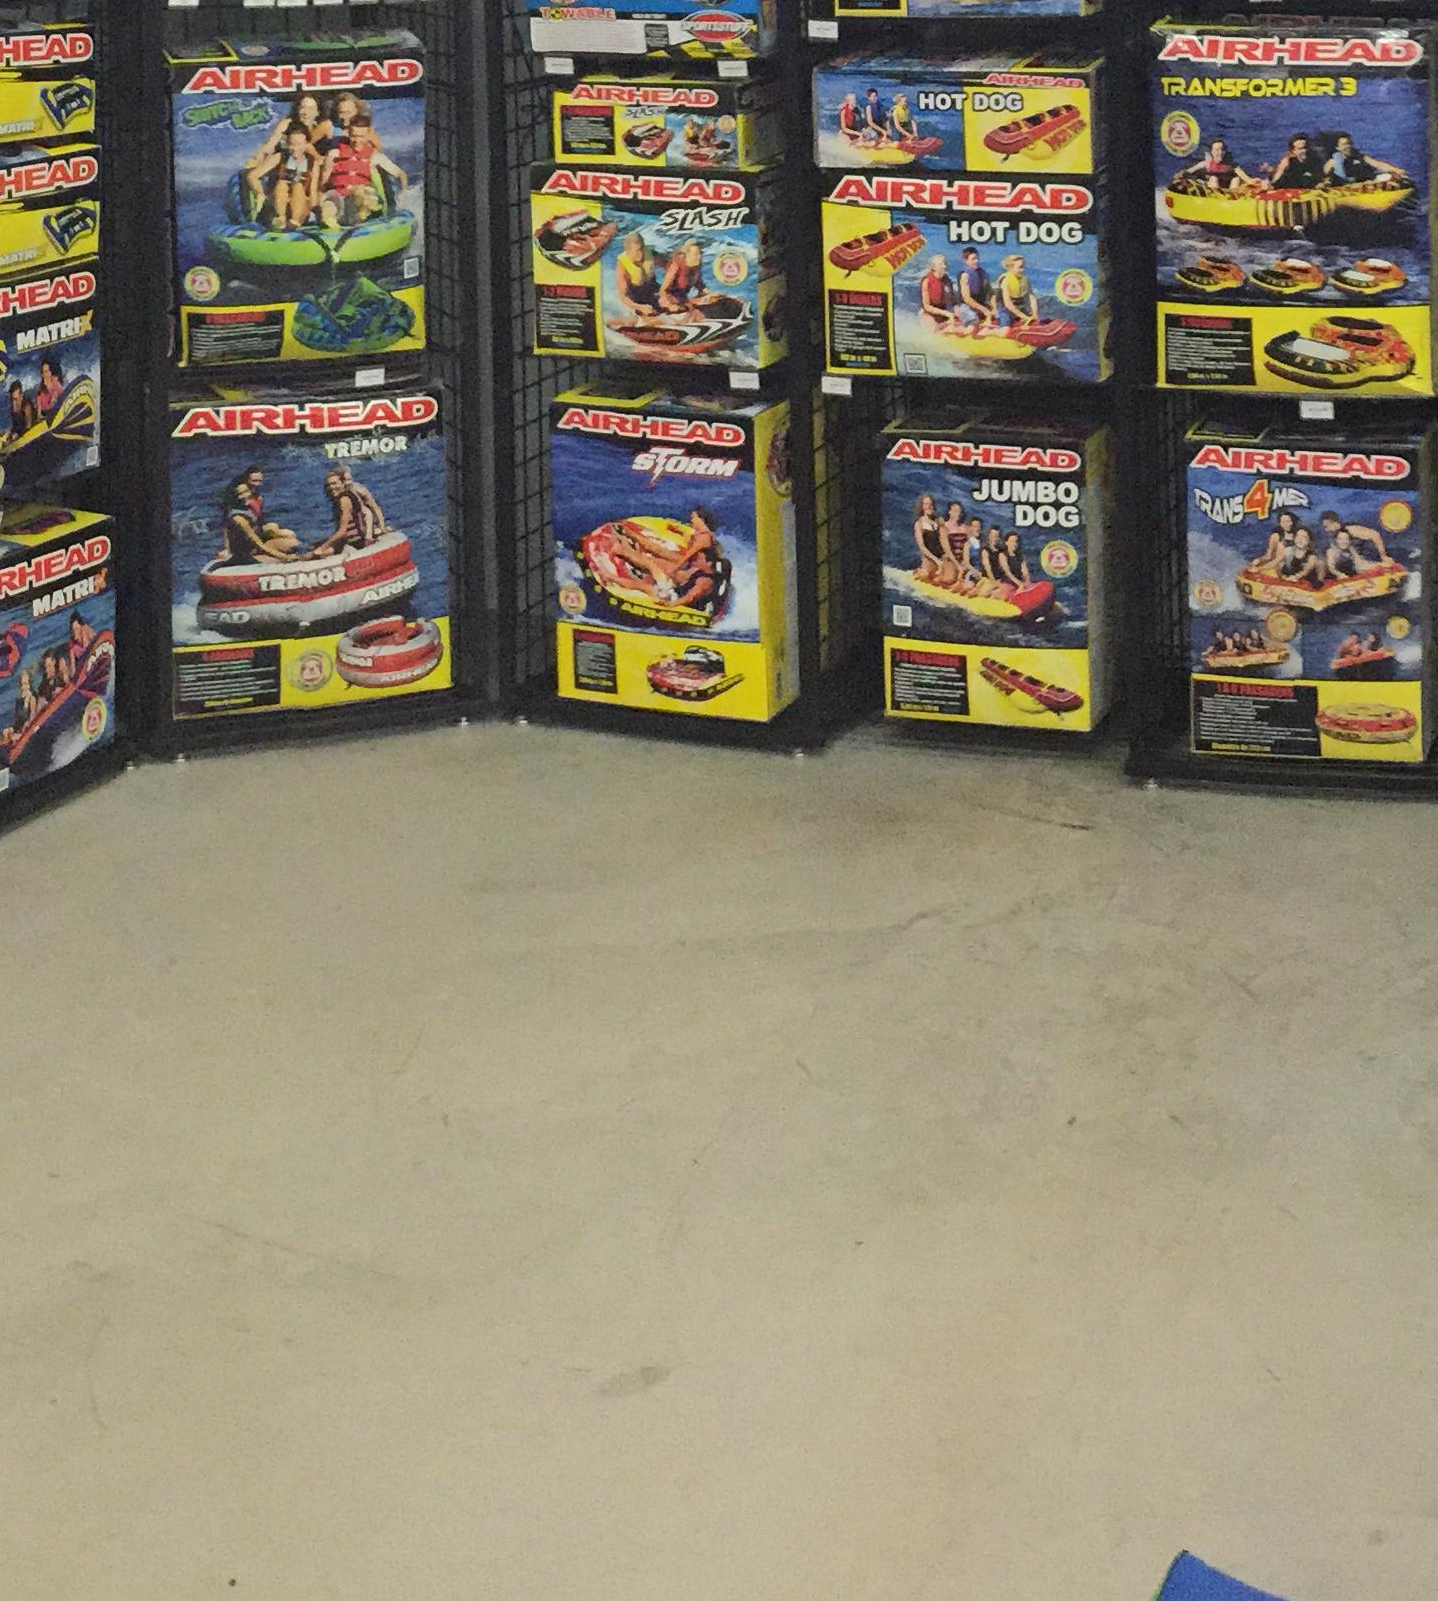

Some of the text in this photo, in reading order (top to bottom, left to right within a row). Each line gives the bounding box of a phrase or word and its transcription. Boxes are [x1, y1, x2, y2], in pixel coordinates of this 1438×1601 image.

[1157, 34, 1424, 67] AIRHEAD
[180, 58, 425, 97] AIRHEAD
[983, 73, 1086, 88] AIRHEAD
[1161, 75, 1359, 97] TRANSFORMER 3
[568, 83, 719, 109] AIRHEAD
[919, 92, 1024, 112] HOT DOG
[542, 169, 745, 204] AIRHEAD
[829, 175, 1094, 215] AIRHEAD
[660, 206, 750, 232] SLASH
[948, 220, 1084, 244] HOT DOG
[16, 309, 94, 353] MATRIX
[171, 395, 439, 438] AIRHEAD
[557, 408, 747, 447] AIRHEAD
[324, 434, 409, 460] TREMOR
[886, 438, 1082, 472] AIRHEAD
[1189, 445, 1411, 480] AIRHEAD
[632, 446, 740, 489] STORM
[972, 478, 1079, 504] JUMBO
[1014, 504, 1080, 528] DOG
[31, 567, 109, 620] MATRIX
[258, 562, 347, 592] TREMOR
